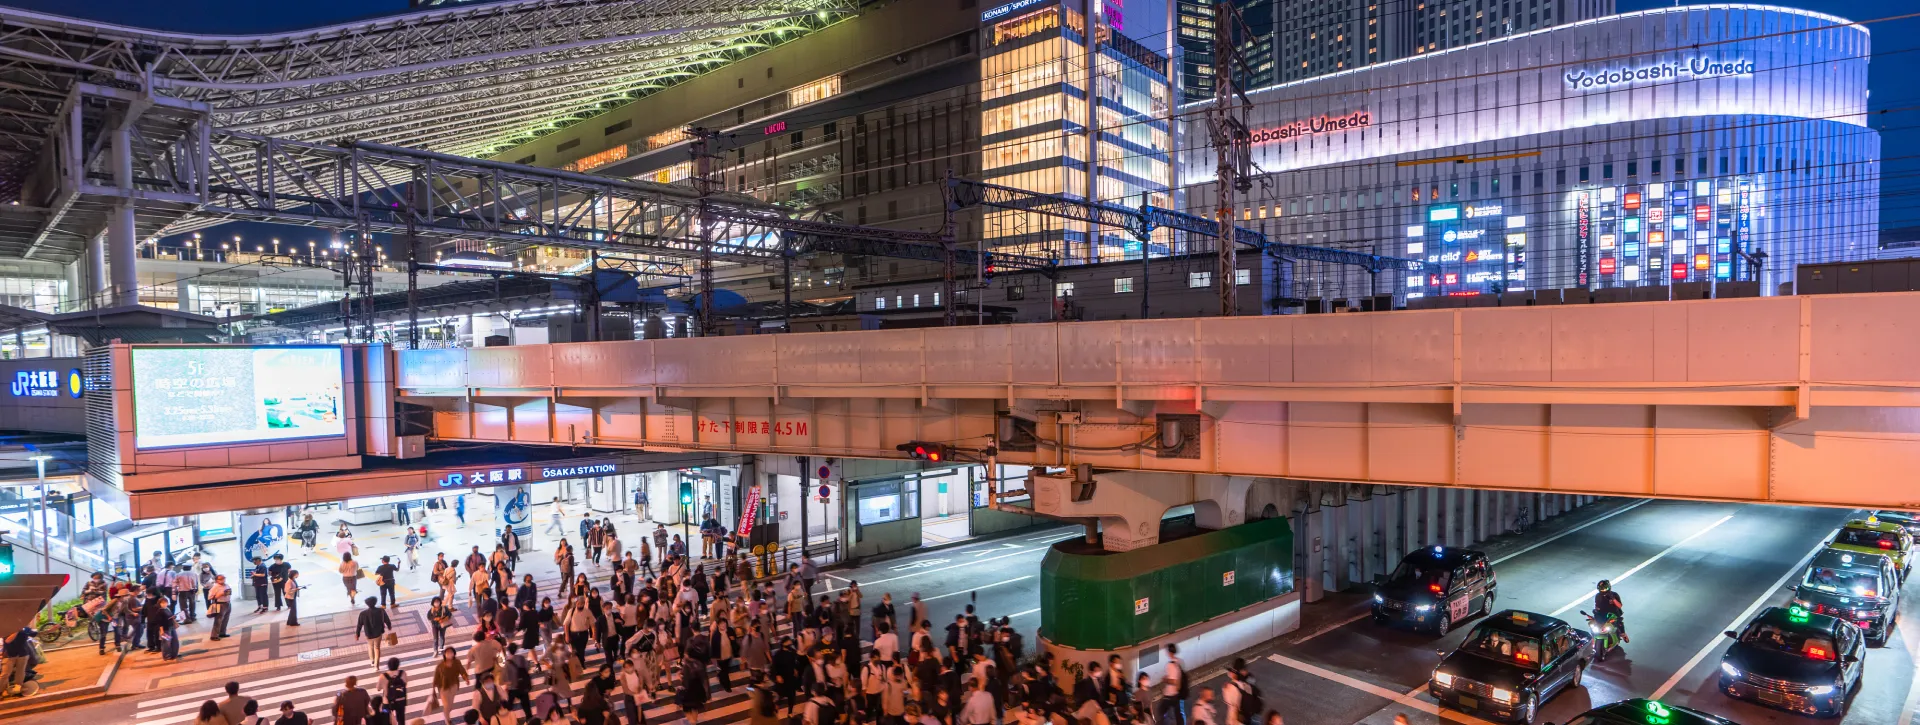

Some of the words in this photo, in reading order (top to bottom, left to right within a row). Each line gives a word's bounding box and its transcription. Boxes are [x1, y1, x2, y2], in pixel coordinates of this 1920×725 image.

[984, 6, 1009, 19] KONAMI
[1567, 57, 1755, 89] Yodobashi-Umeda
[187, 360, 205, 375] 5F
[12, 371, 30, 396] JR
[439, 473, 463, 487] JR
[470, 468, 522, 484] 大阪駅
[577, 464, 616, 475] STATION
